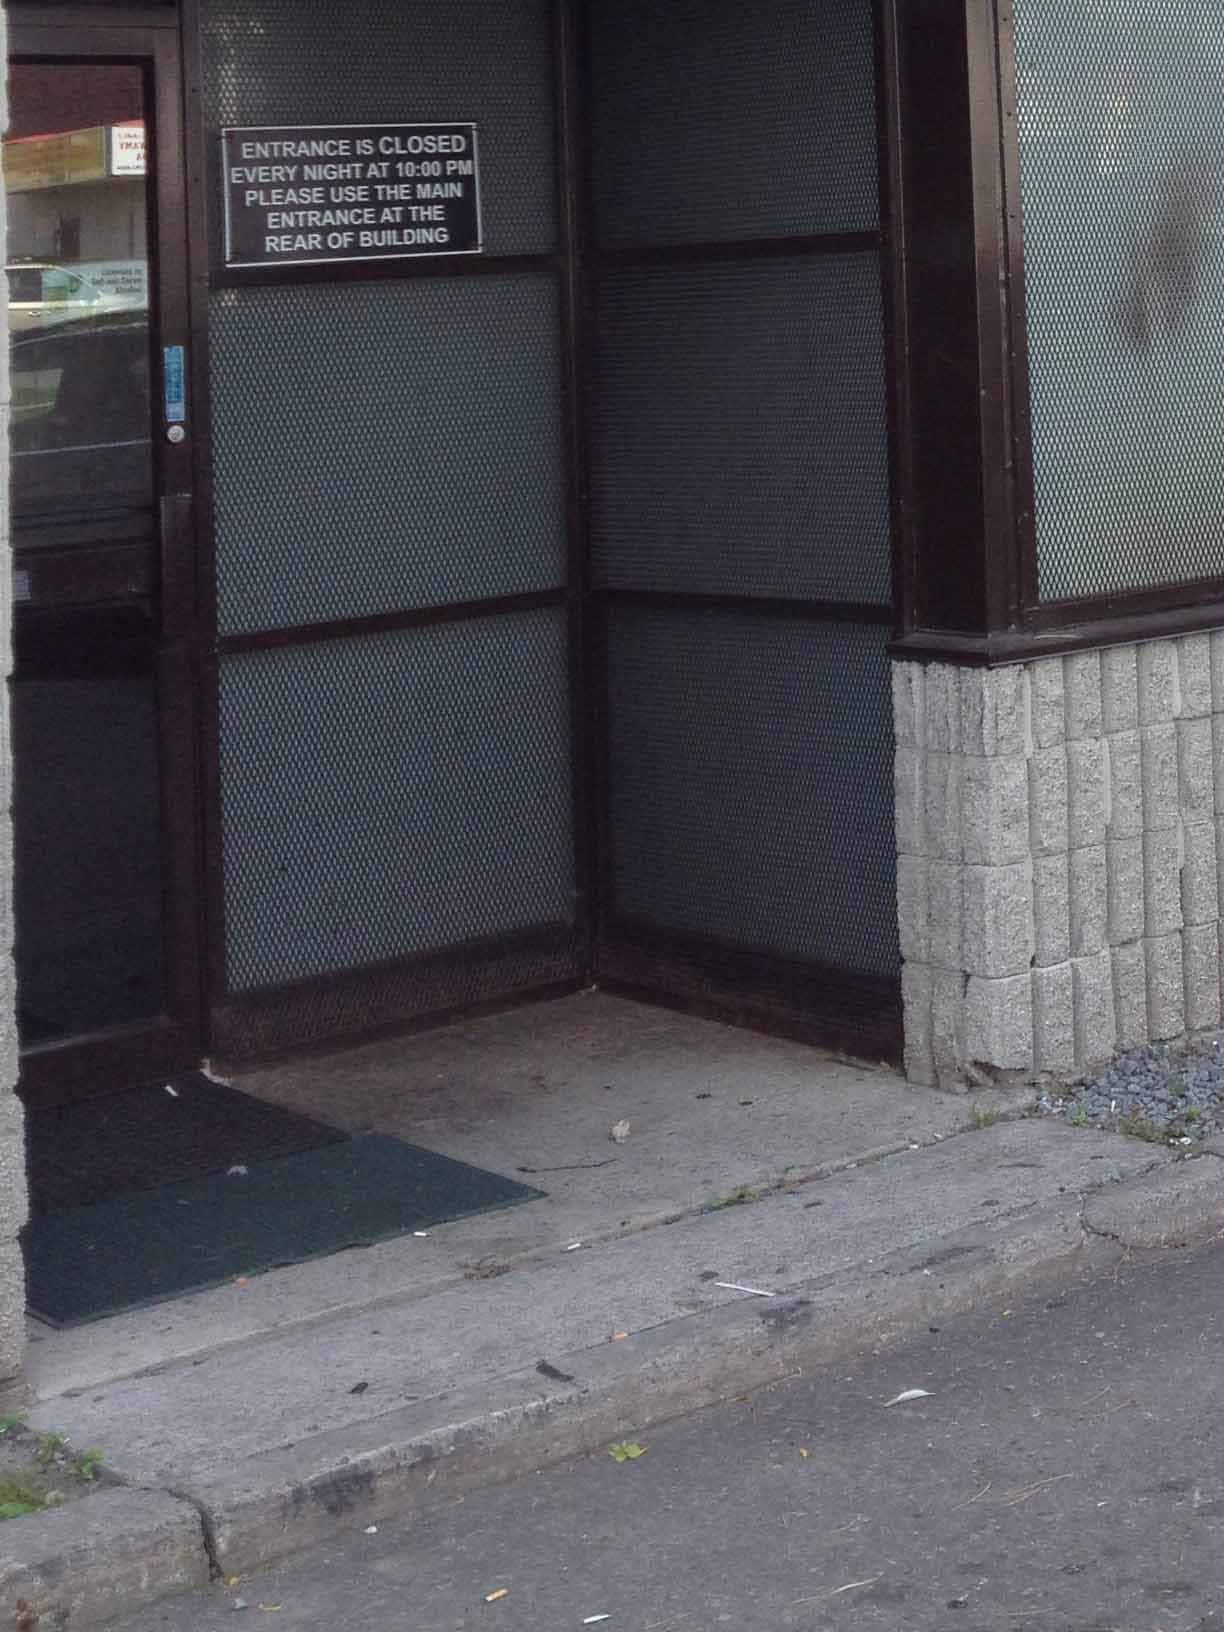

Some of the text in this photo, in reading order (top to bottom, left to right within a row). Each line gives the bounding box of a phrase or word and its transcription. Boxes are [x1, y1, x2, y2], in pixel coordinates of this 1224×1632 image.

[241, 135, 466, 159] ENTRANCE IS CLOSED
[231, 160, 473, 184] EVERY NIGHT AT 10:00 PM
[245, 182, 463, 206] PLEASE USE THE MAIN
[267, 205, 445, 229] ENTRANCE AT THE
[265, 227, 449, 253] REAR OF BUILDING
